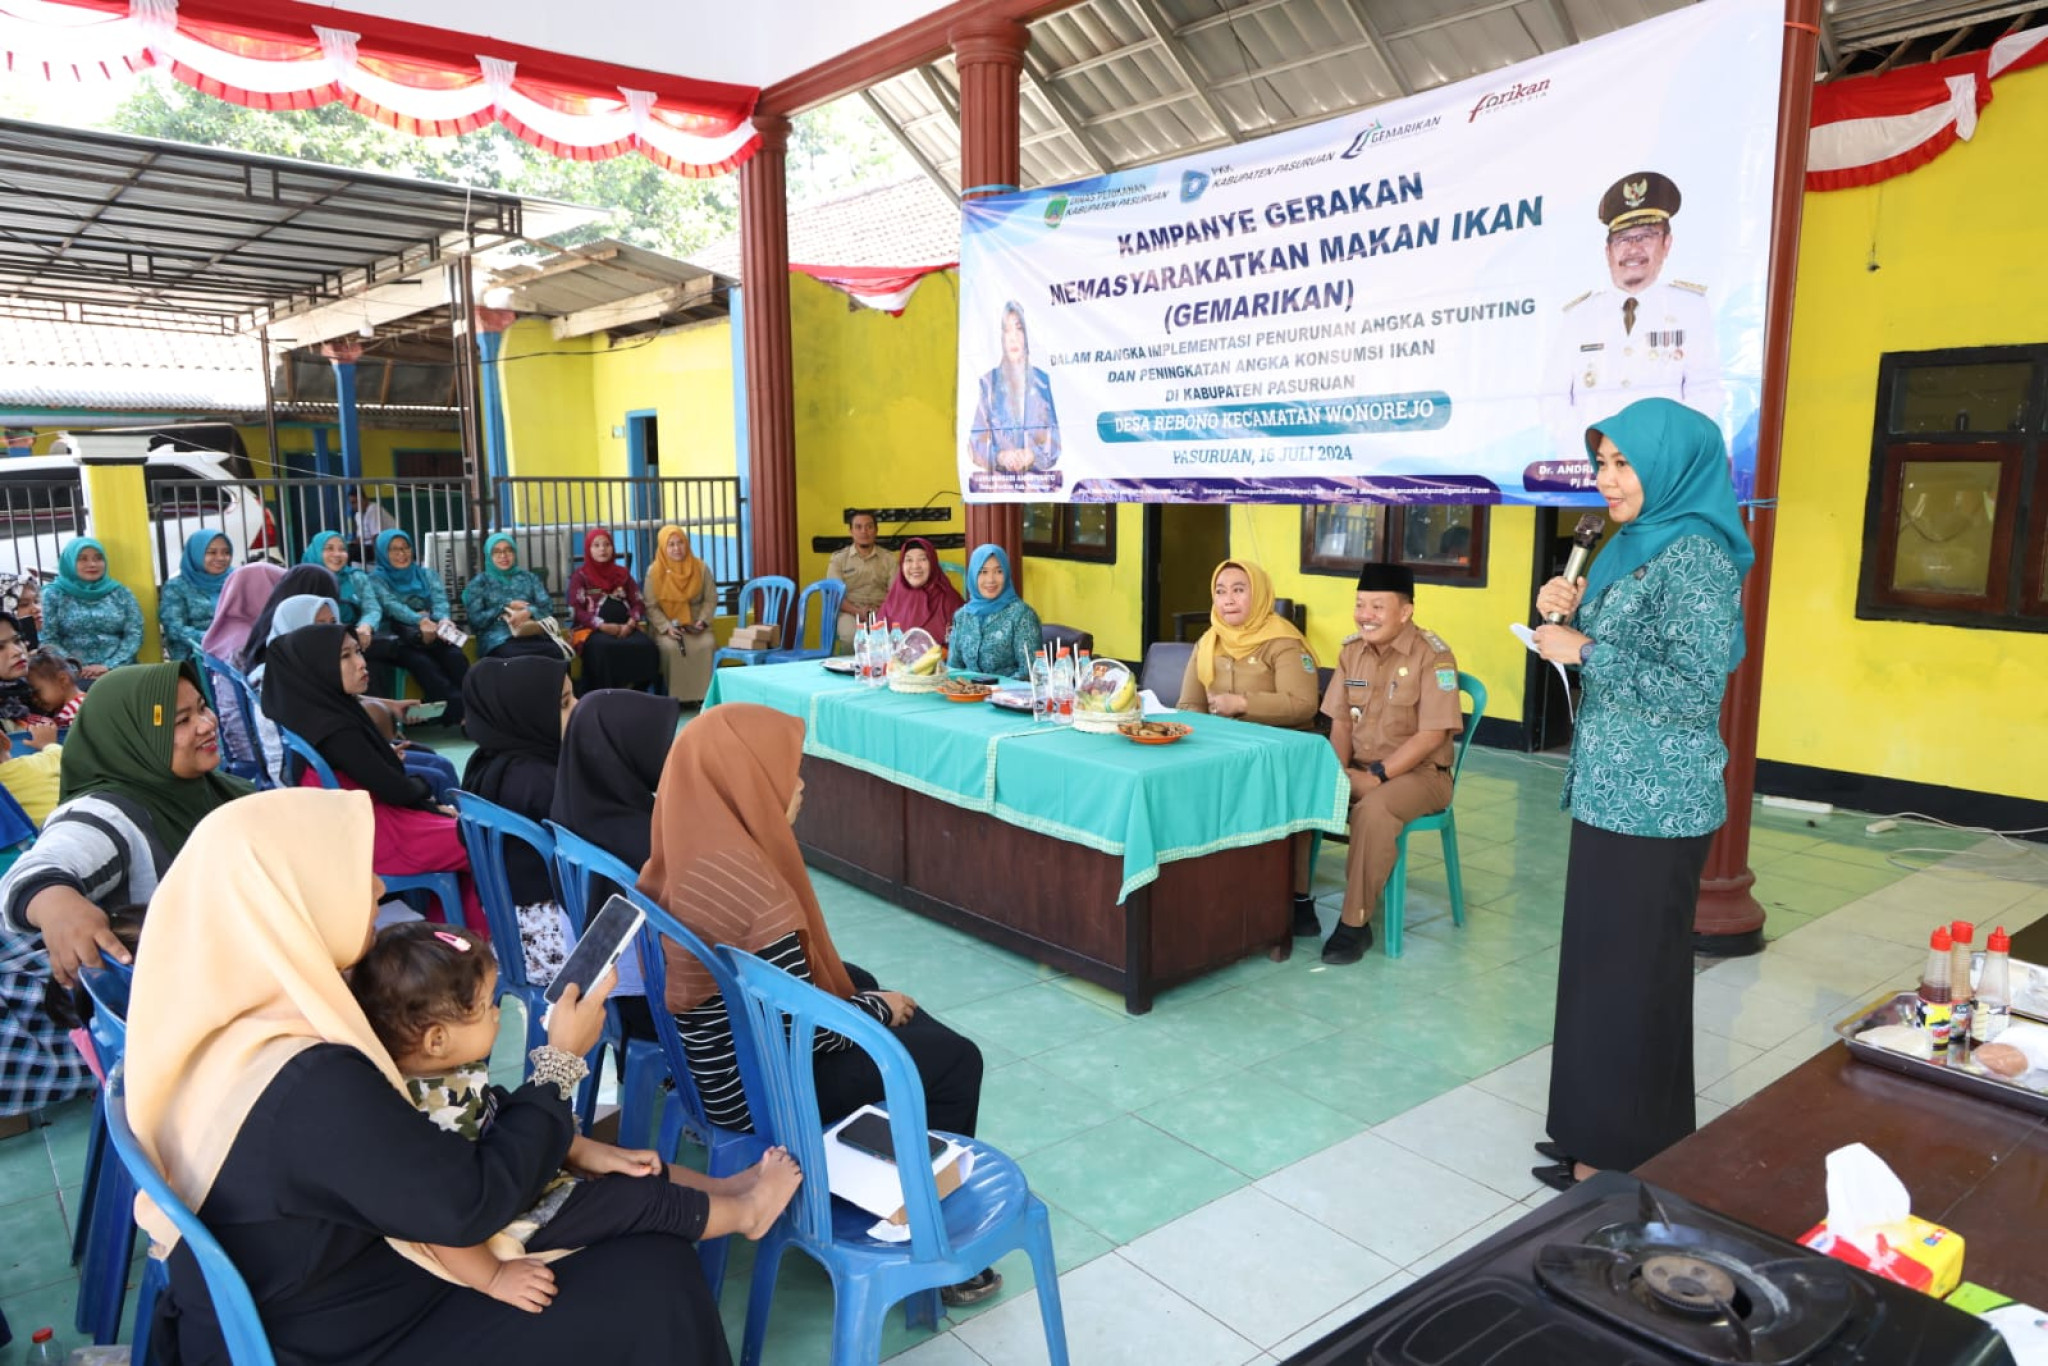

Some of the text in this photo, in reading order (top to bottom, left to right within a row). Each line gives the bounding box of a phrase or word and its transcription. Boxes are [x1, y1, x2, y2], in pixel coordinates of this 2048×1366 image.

[1372, 115, 1442, 143] GEMARIKAN
[1212, 151, 1335, 188] KABUPATEN PASURUAN
[1118, 172, 1423, 258] KAMPANYE GERAKAN
[1049, 196, 1543, 306] MEMASYARAKATKAN MAKAN IKAN
[1164, 279, 1354, 335] (GEMARIKAN)
[1050, 298, 1536, 367] DALAM RANGKA IMPLEMENTASI PENURUNAN ANGKA STUNTING
[1107, 339, 1436, 383] DAN PENINGKATAN ANGKA KONSUMSI IKAN
[1165, 375, 1356, 402] DI KABUPATEN PASURUAN
[1115, 399, 1435, 433] DESA REBONO KECAMATAN WONOREJO
[1173, 446, 1256, 466] PASURUAN,
[1278, 446, 1314, 463] JULI
[1317, 445, 1354, 462] 2024
[1538, 465, 1554, 475] Dr.
